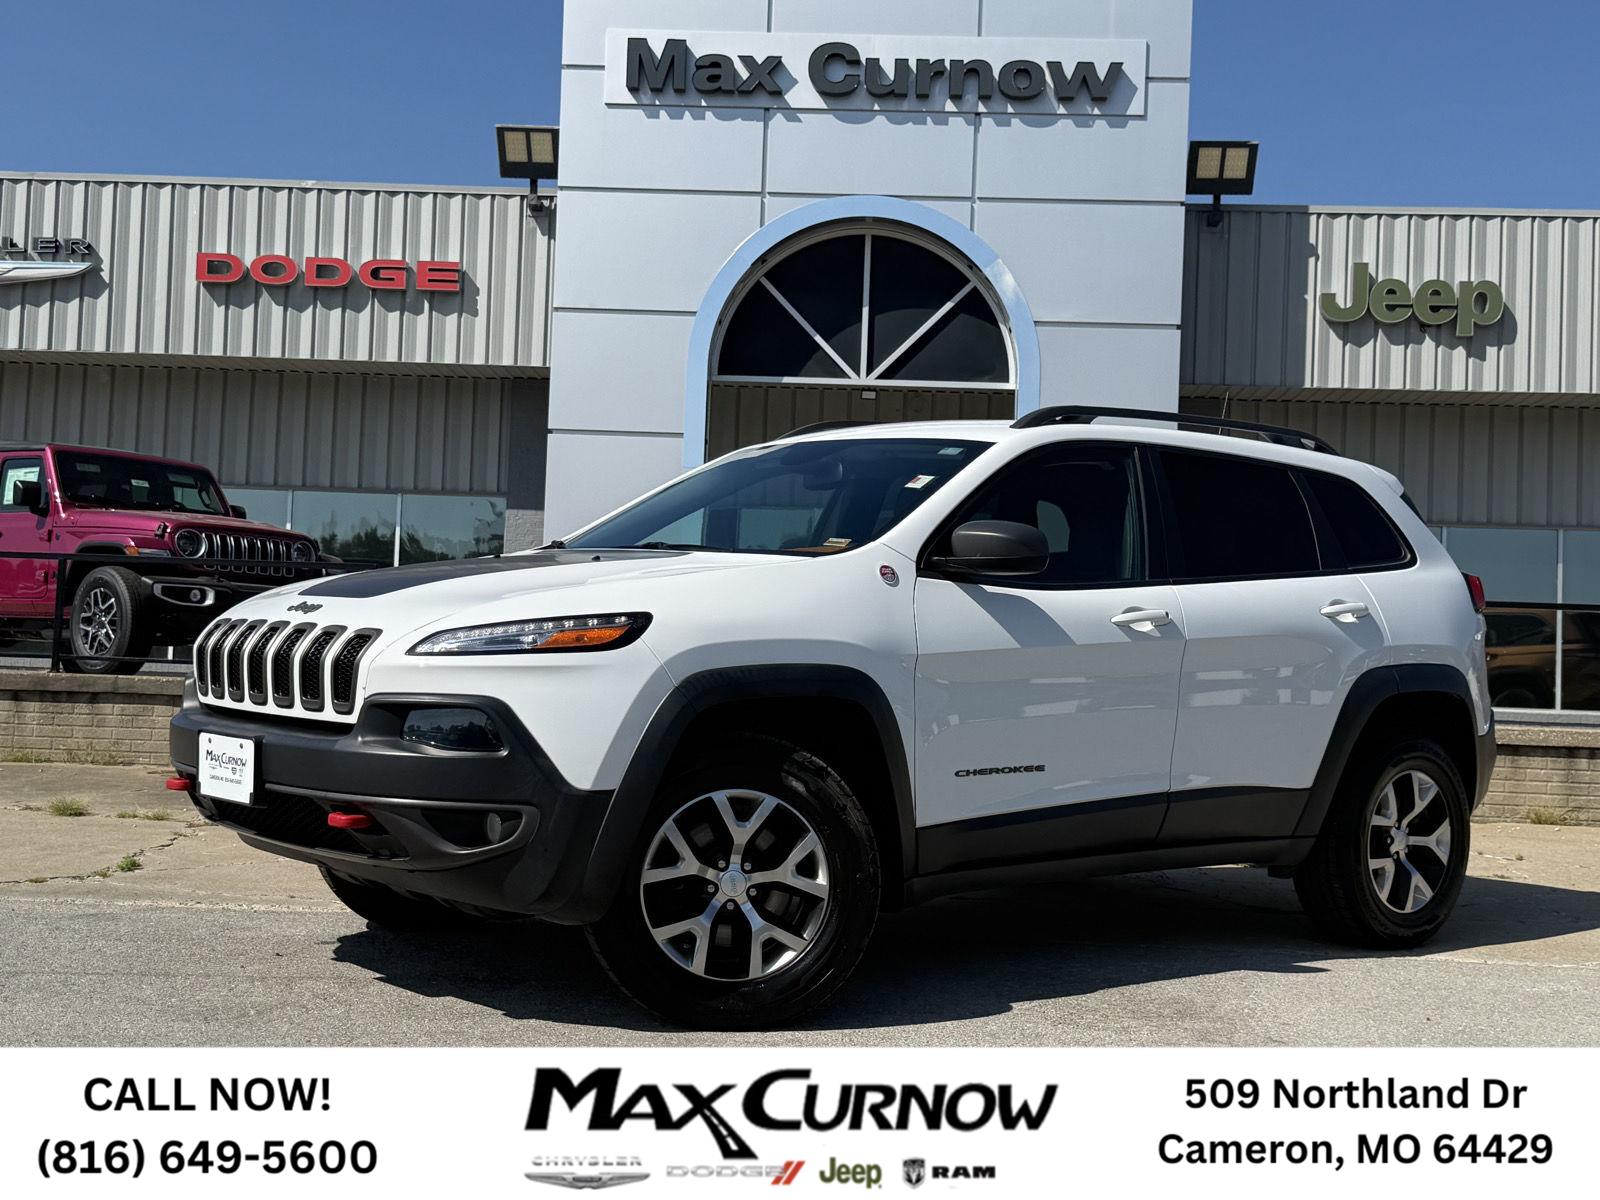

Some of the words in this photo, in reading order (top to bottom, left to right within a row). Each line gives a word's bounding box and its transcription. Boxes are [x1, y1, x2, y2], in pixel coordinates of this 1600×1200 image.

[625, 38, 783, 94] Max
[808, 42, 1124, 101] Curnow
[196, 252, 461, 292] DODGE
[1319, 262, 1504, 337] Jeep
[286, 601, 323, 614] Jeep
[954, 764, 1046, 778] CHEROKEE
